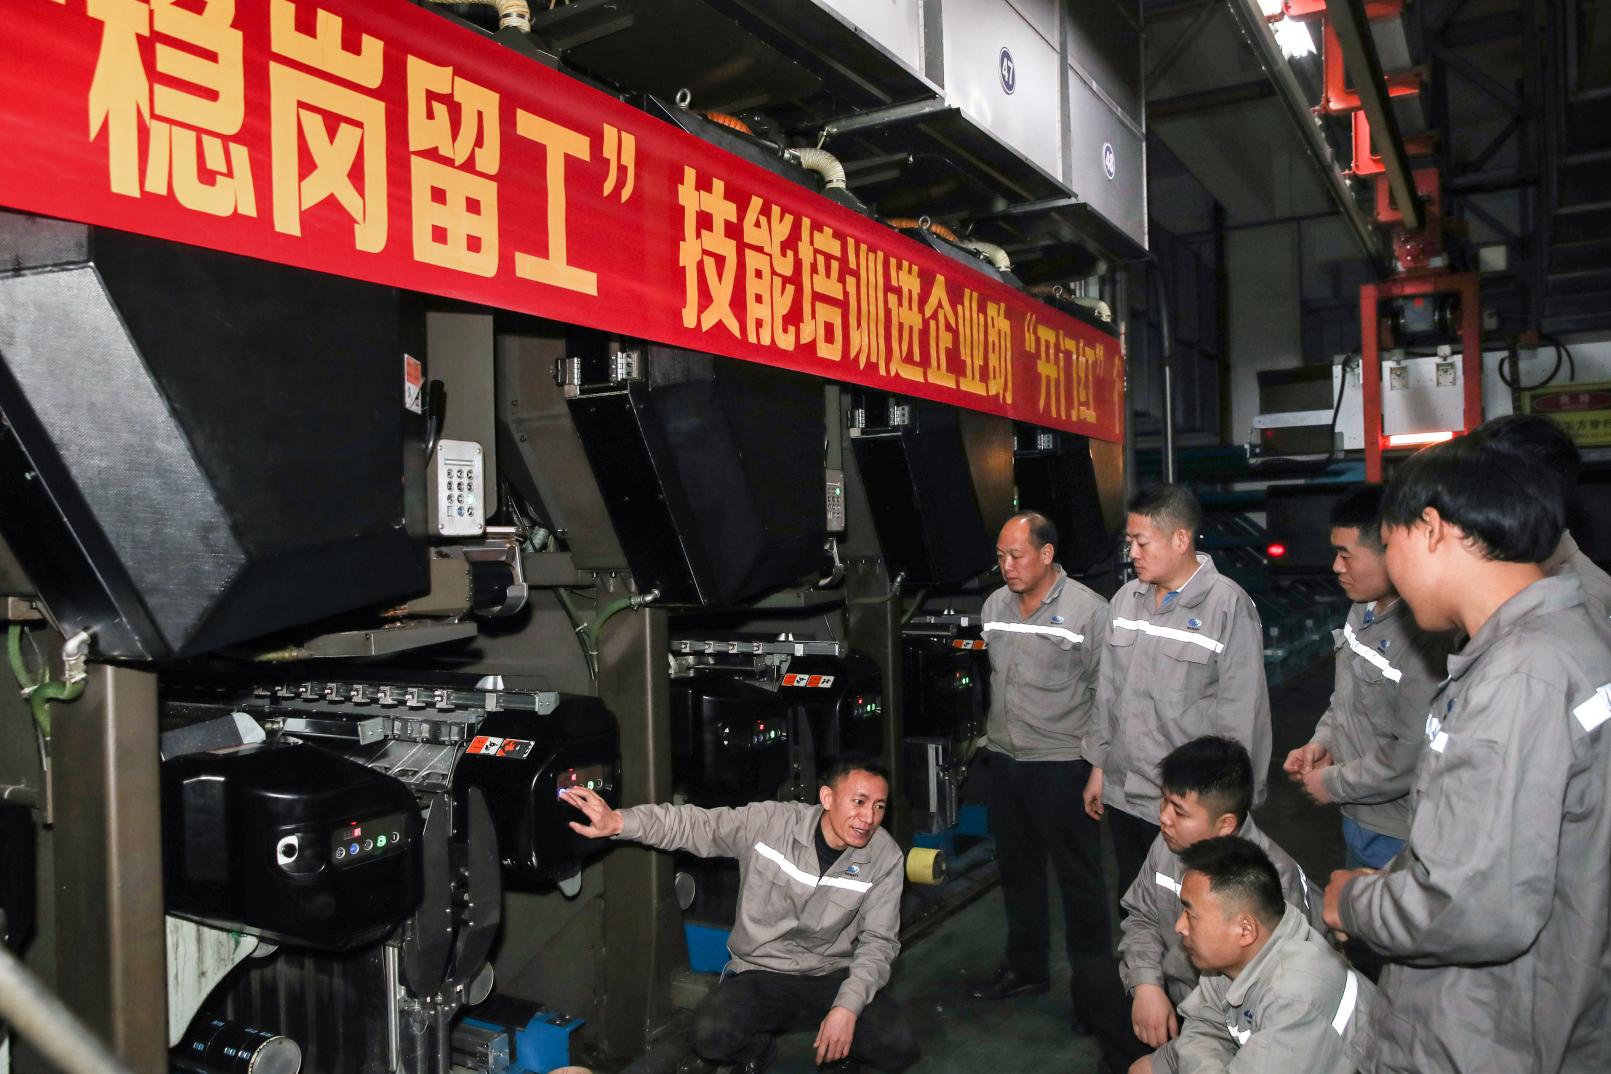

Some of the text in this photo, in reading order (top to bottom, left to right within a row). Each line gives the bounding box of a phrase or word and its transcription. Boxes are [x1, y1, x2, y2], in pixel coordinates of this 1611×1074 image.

[1001, 57, 1014, 85] 47
[1104, 150, 1115, 174] 48
[52, 0, 1123, 434] 稳岗留工”技能培训进企业助“开门红”
